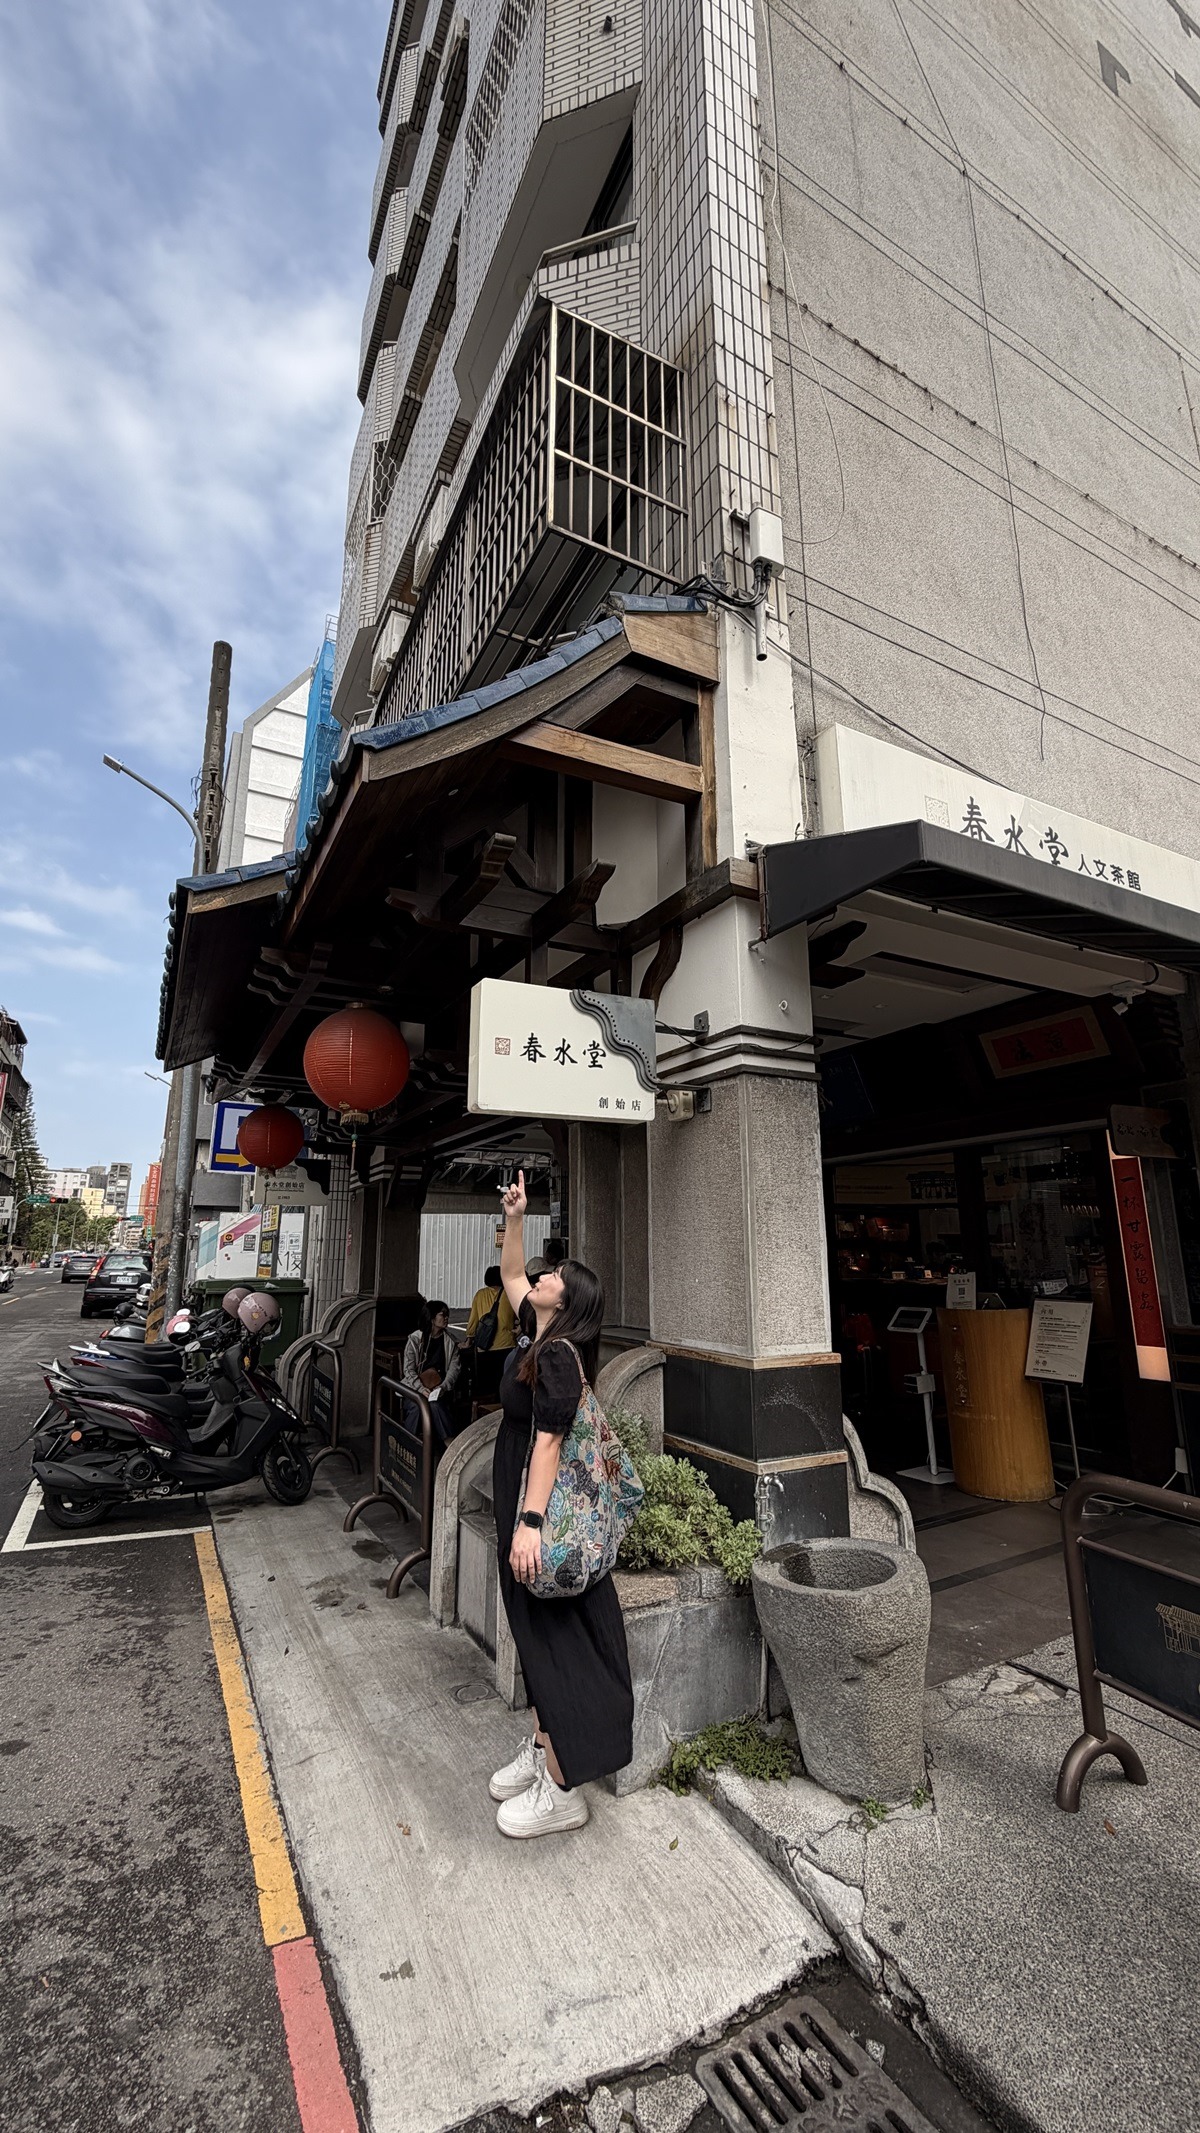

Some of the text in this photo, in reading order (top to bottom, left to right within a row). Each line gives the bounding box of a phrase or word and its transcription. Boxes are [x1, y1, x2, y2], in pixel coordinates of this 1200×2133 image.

[960, 796, 1069, 865] 春水堂
[1077, 853, 1142, 891] 人文茶館
[519, 1032, 607, 1069] 春水堂
[598, 1096, 641, 1112] 創始店
